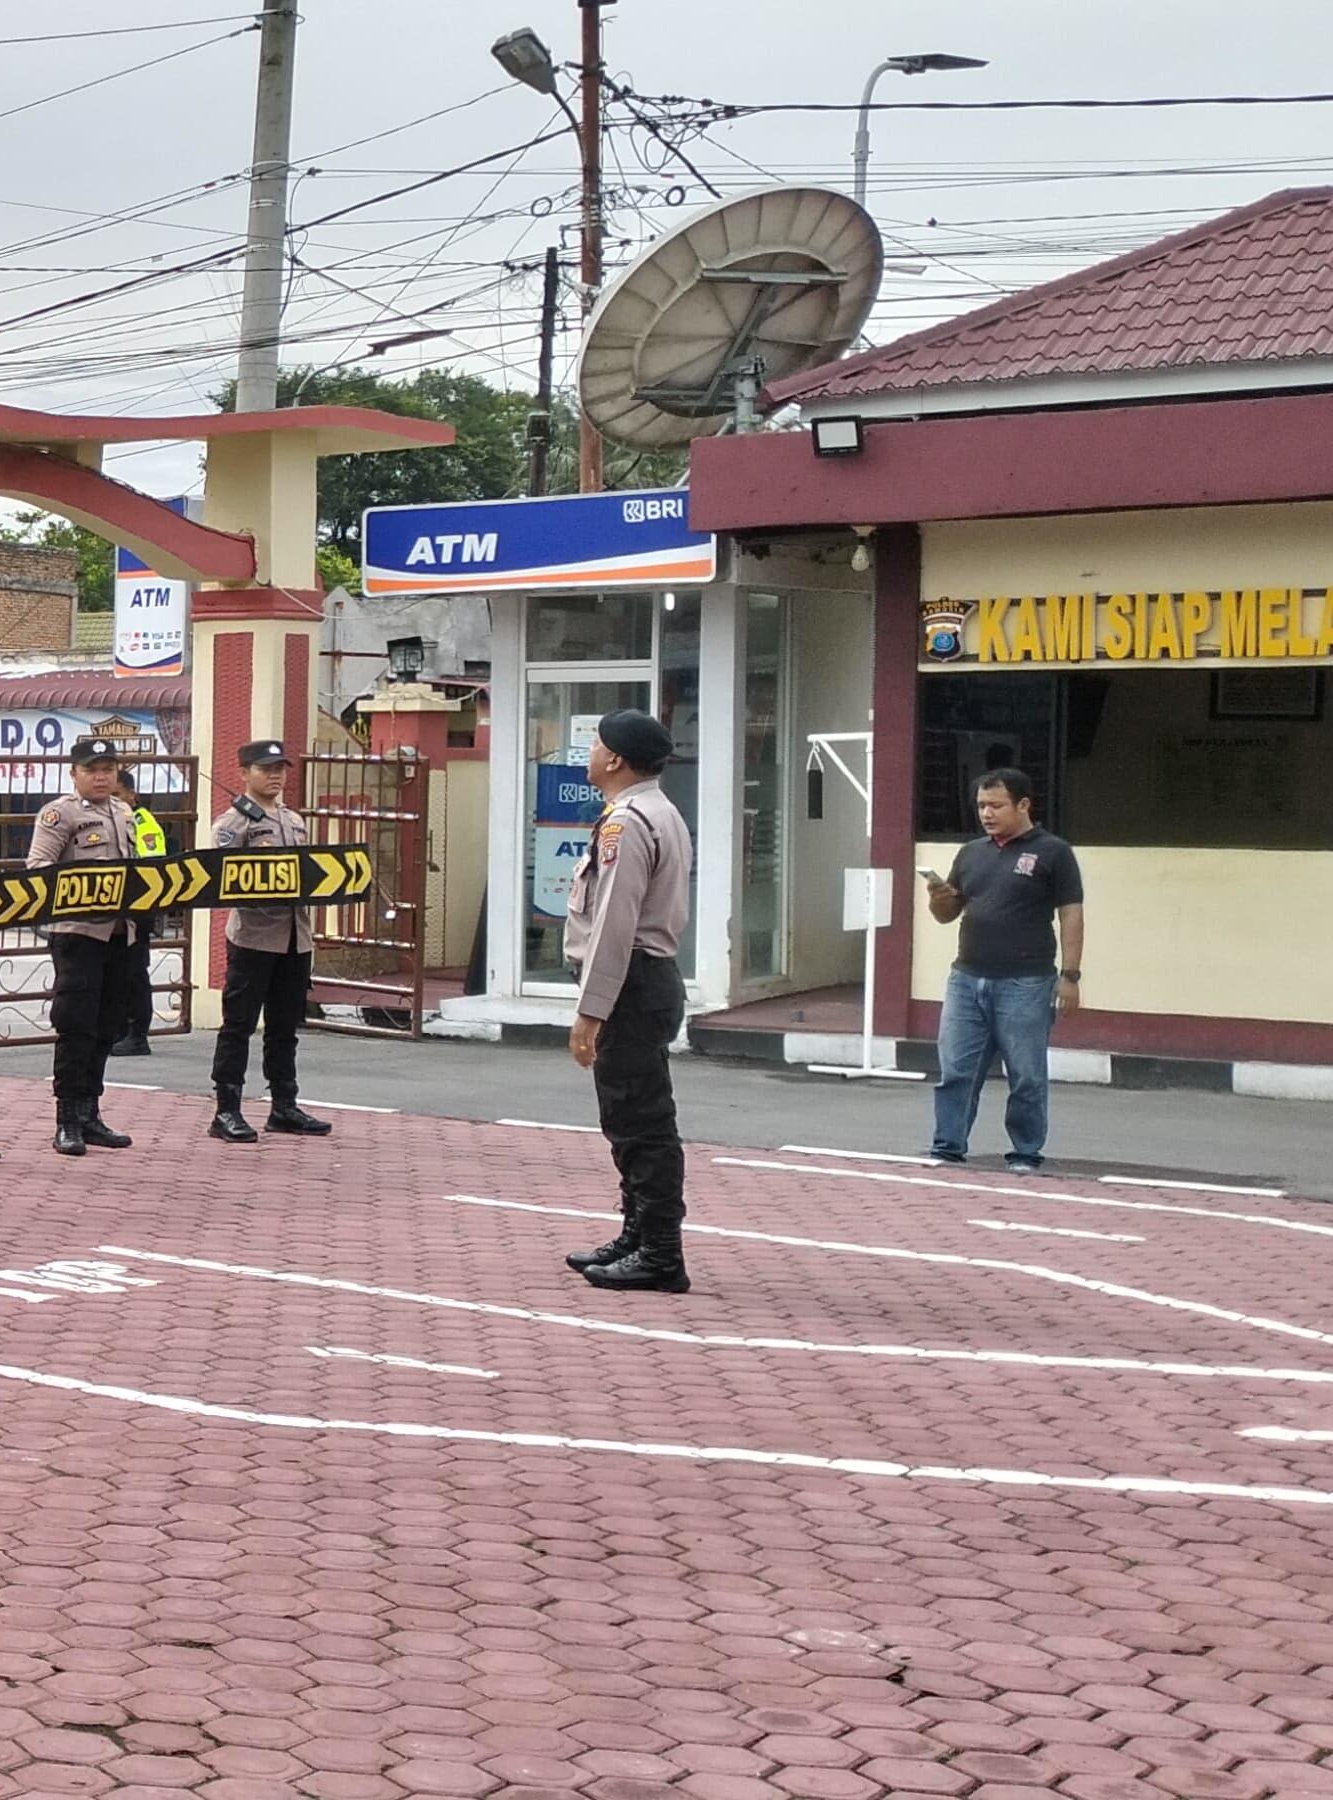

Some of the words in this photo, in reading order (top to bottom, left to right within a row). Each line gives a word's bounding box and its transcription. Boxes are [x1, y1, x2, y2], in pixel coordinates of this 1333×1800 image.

[646, 499, 683, 519] BRI
[405, 533, 498, 565] ATM
[130, 587, 171, 608] ATM
[978, 592, 1096, 663] KAMI
[1103, 590, 1213, 661] SIAP
[555, 840, 589, 857] AT
[57, 874, 122, 907] POLISI
[225, 859, 296, 893] POLISI
